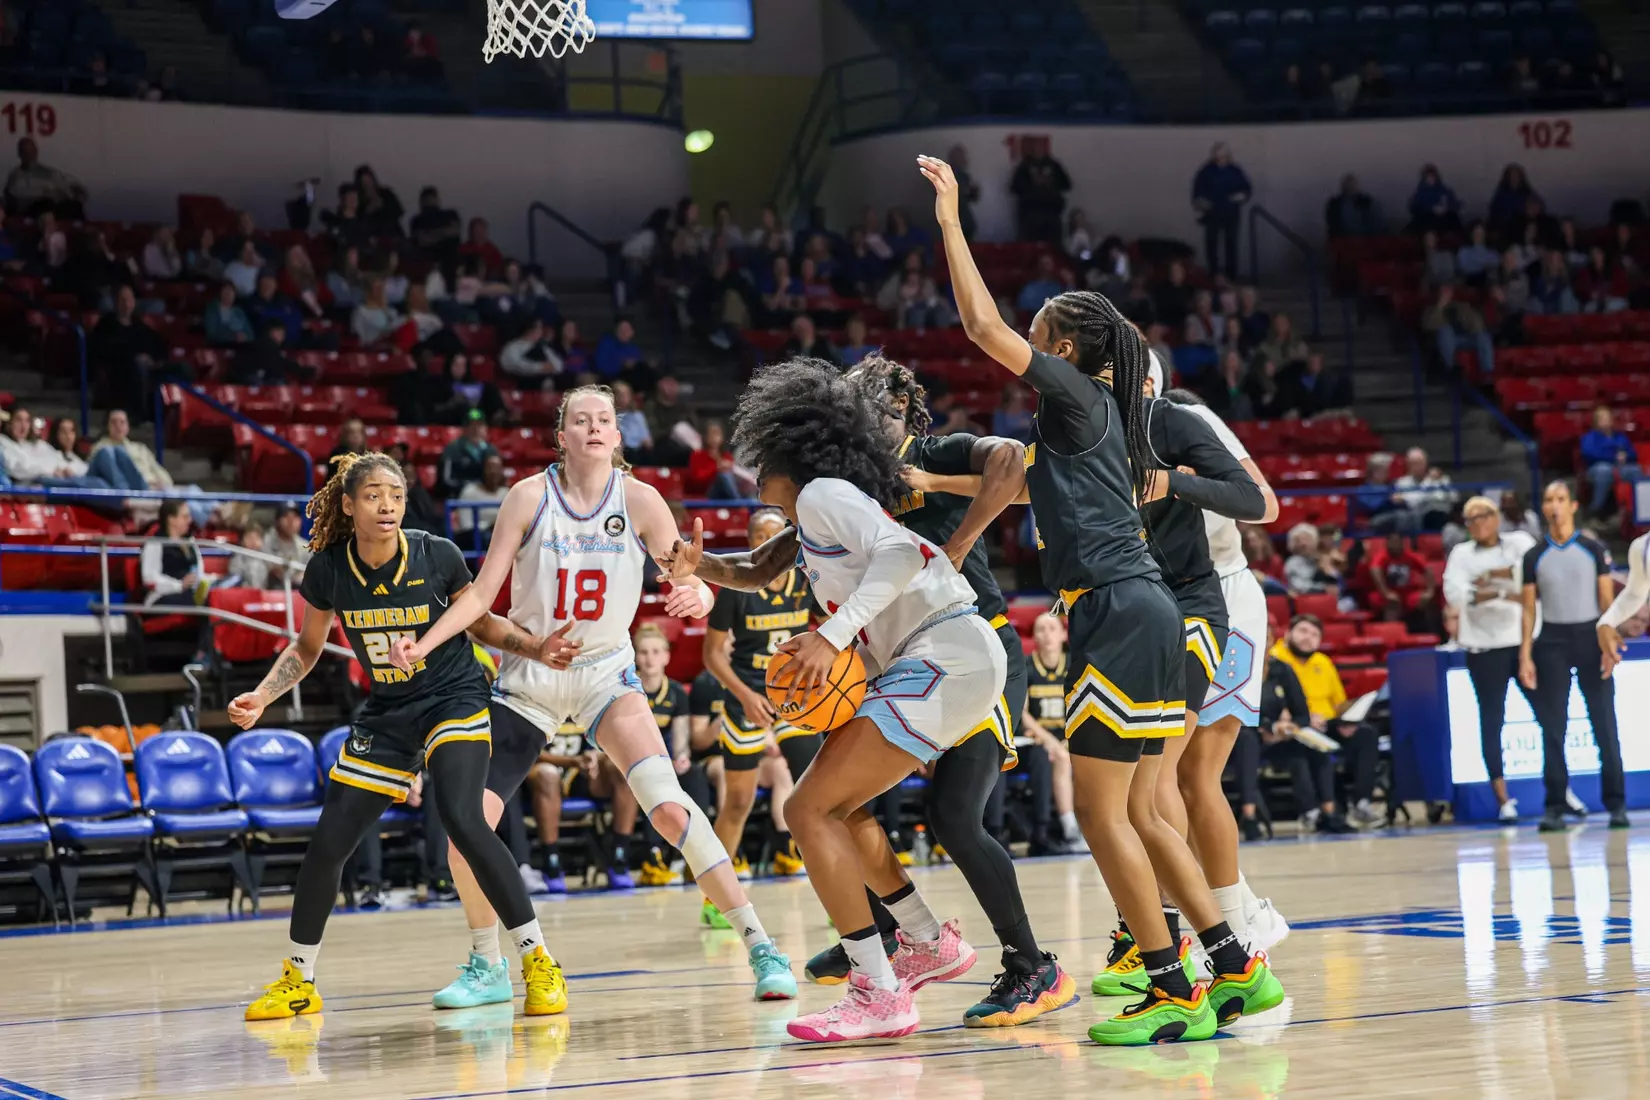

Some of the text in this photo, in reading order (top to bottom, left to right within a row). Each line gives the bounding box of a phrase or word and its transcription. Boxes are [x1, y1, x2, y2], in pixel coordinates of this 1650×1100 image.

[1, 102, 56, 136] 119
[1517, 120, 1573, 149] 102
[553, 567, 607, 621] 18
[342, 604, 430, 629] KENNESAW
